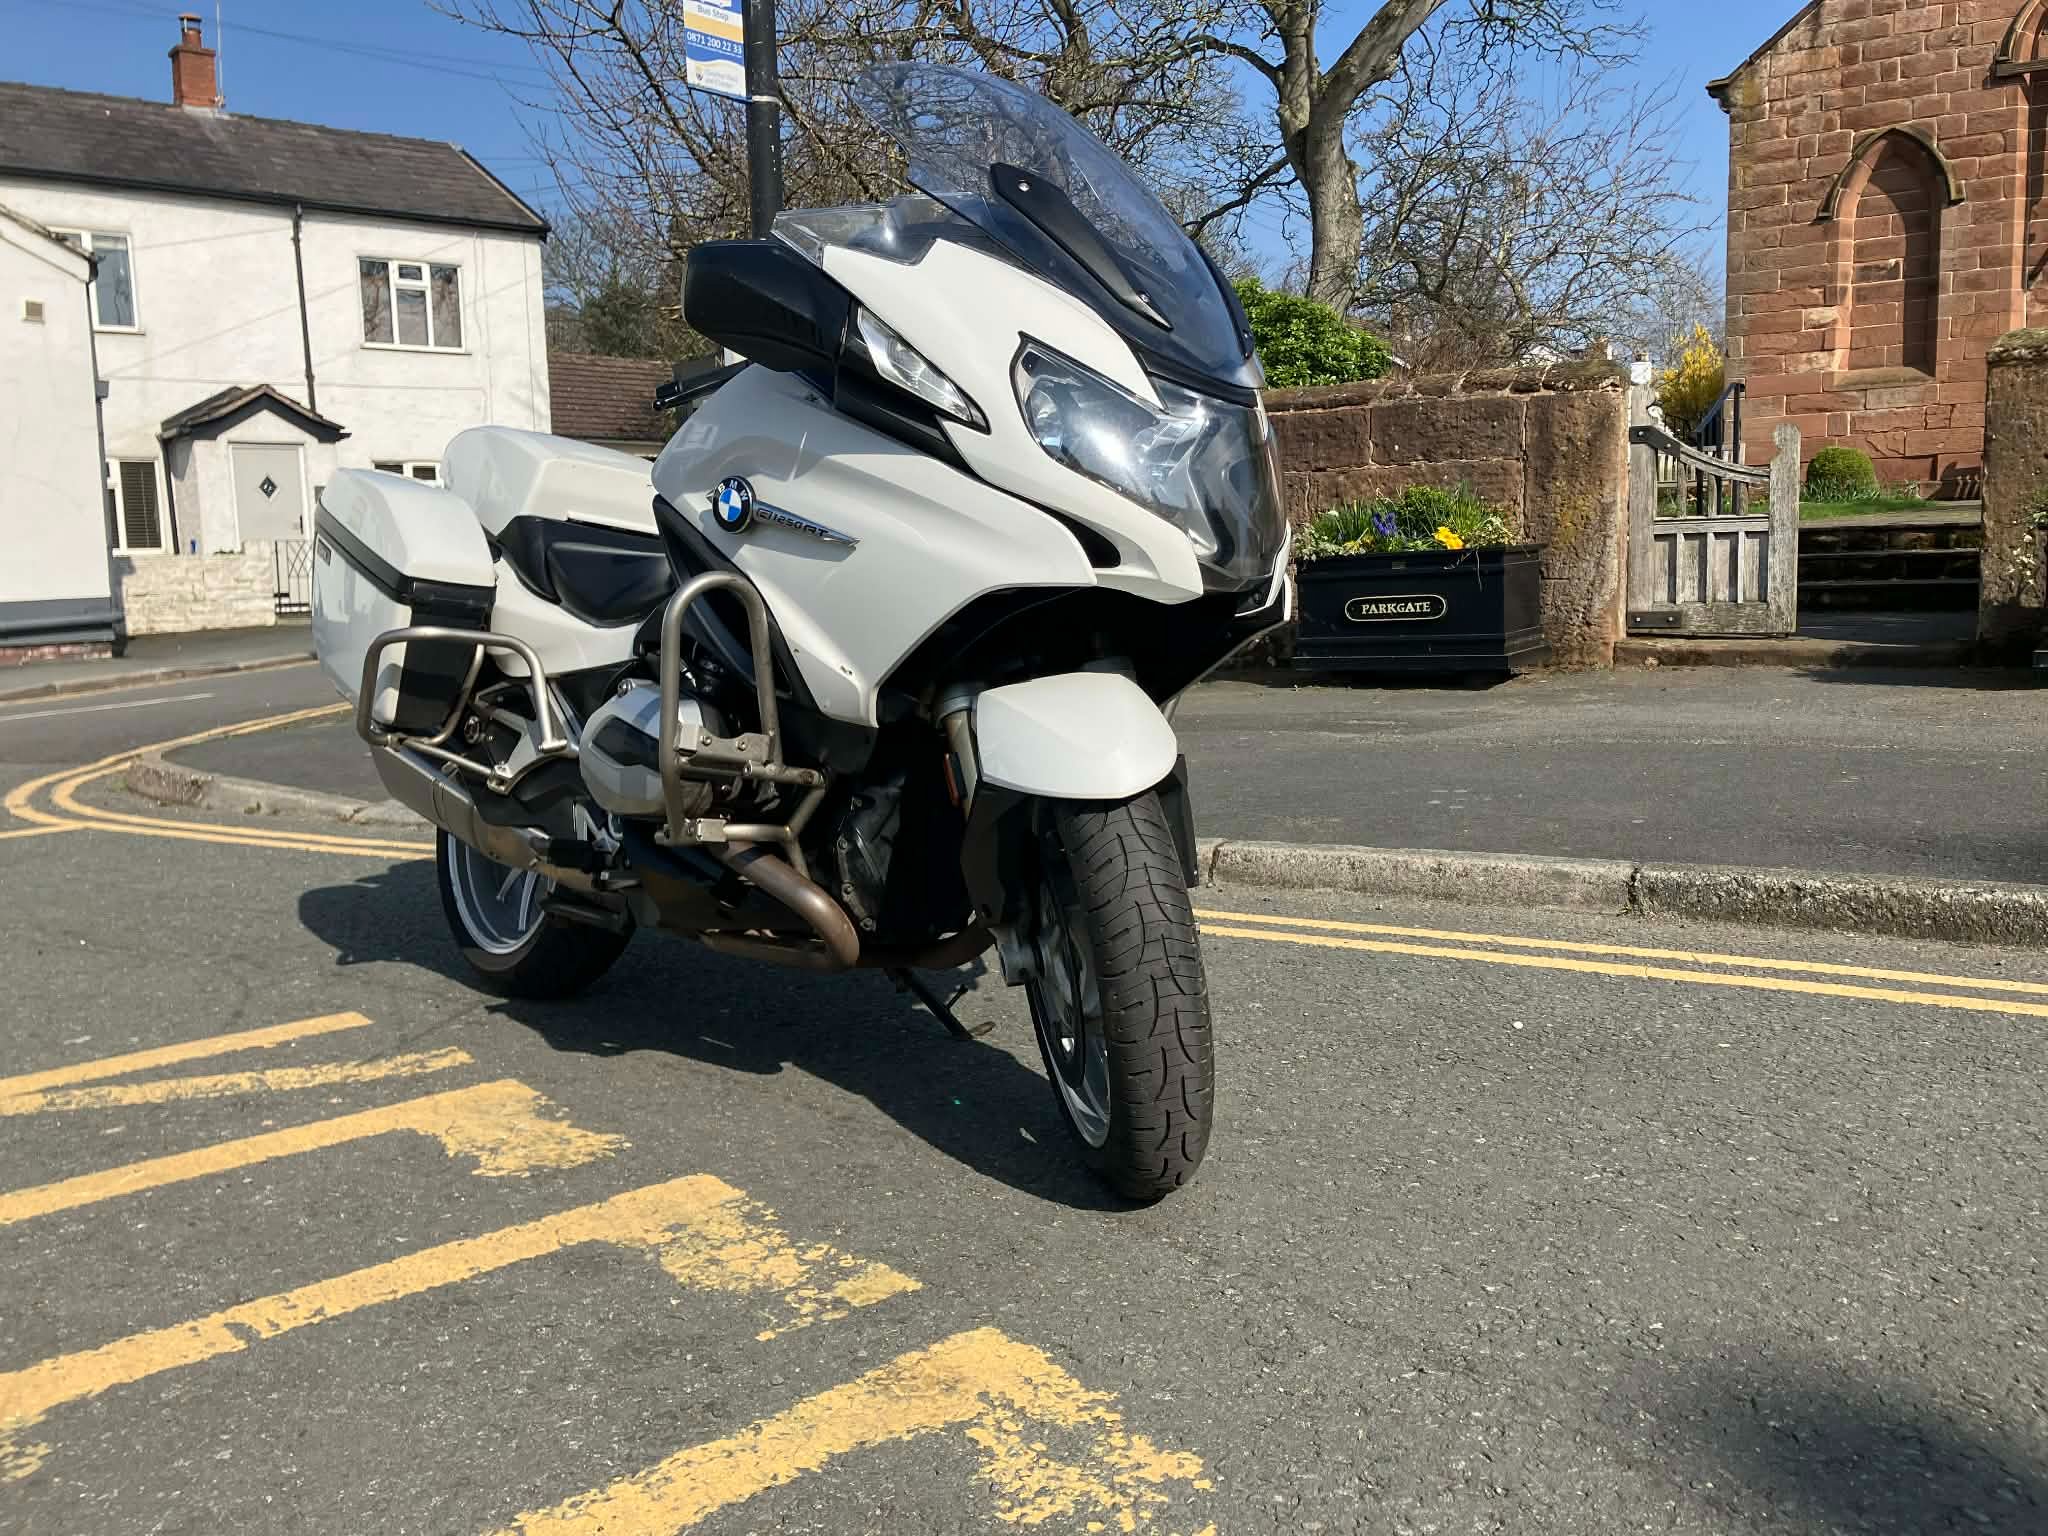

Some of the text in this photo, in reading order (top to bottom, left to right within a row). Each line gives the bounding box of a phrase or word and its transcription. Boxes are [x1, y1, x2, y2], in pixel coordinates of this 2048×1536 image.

[697, 4, 711, 16] Bus
[687, 31, 705, 45] 0871
[707, 37, 721, 48] 200
[722, 41, 731, 51] 22
[733, 43, 742, 54] 33
[1361, 602, 1431, 615] PARKGATE
